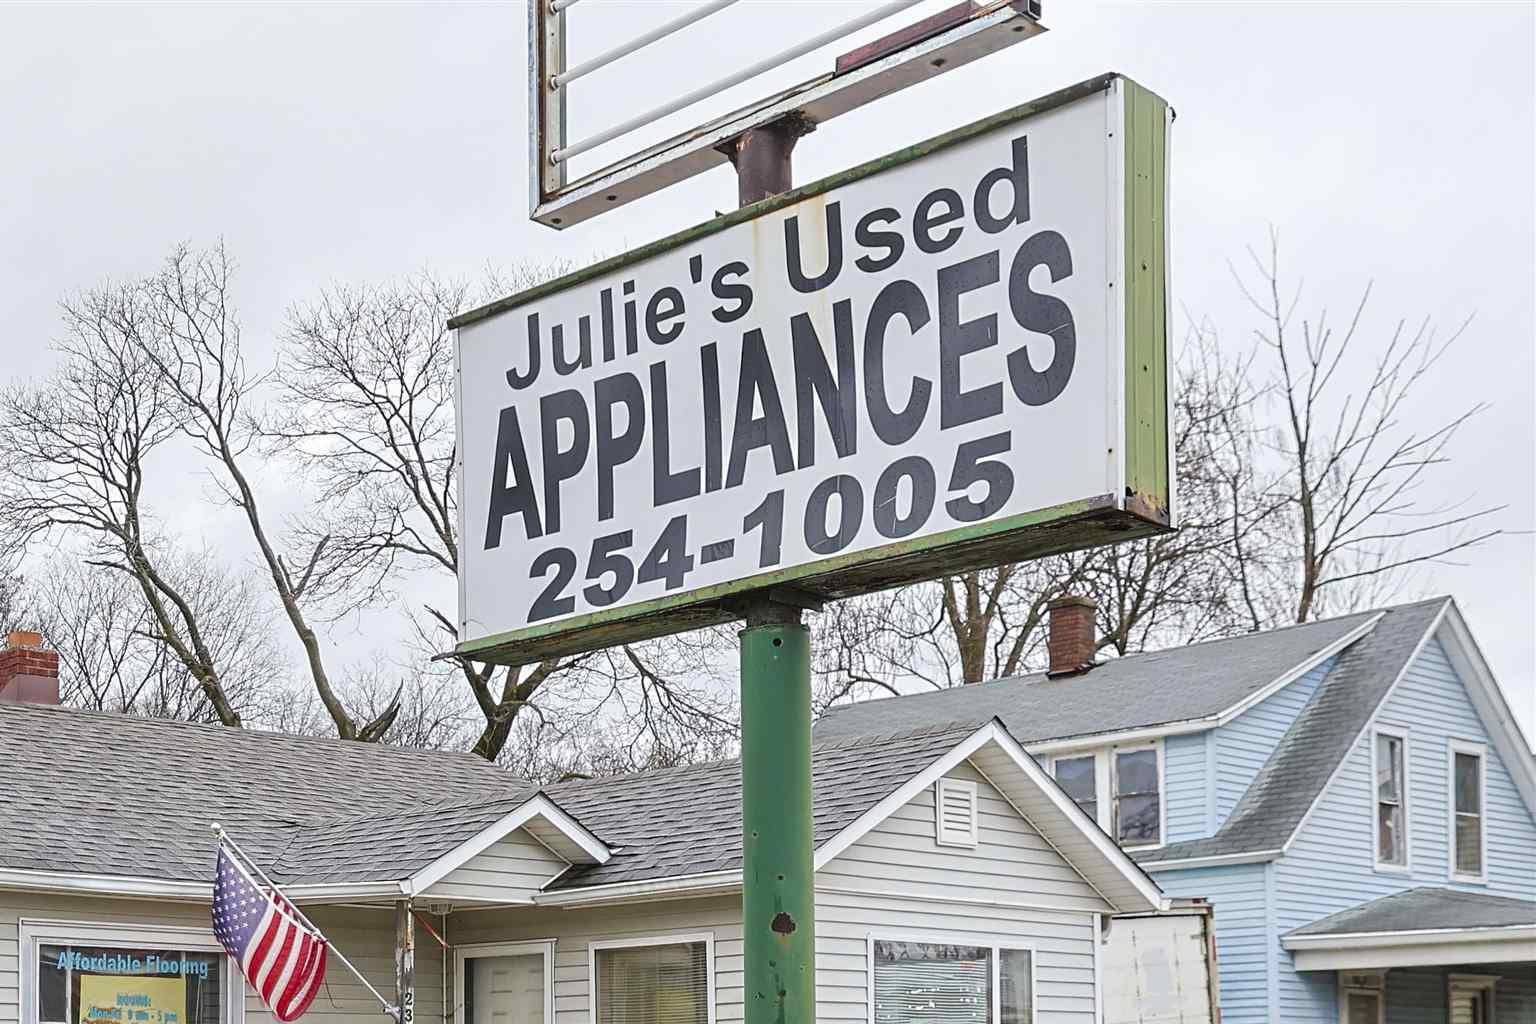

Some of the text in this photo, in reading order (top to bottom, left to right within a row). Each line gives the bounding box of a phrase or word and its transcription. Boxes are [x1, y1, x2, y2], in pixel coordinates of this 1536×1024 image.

[507, 135, 1032, 390] Julie's Used
[483, 230, 1077, 551] APPLIANCES
[526, 430, 1015, 624] 254-1005
[57, 951, 208, 979] Affordable Flooring
